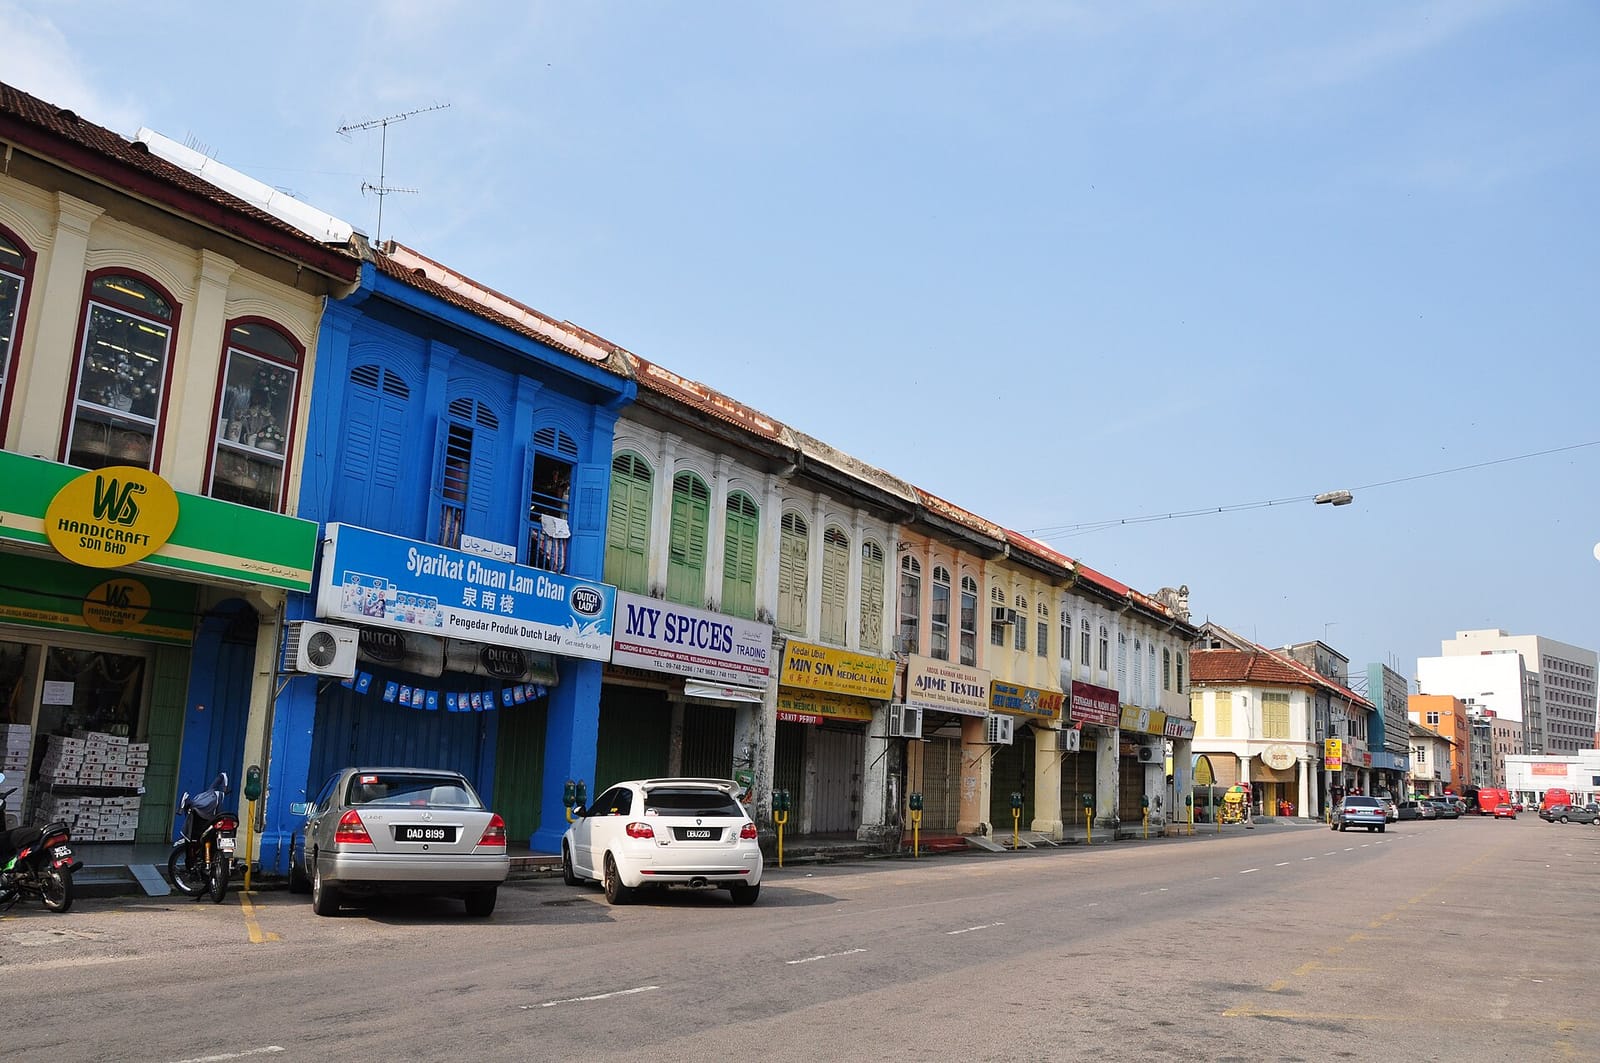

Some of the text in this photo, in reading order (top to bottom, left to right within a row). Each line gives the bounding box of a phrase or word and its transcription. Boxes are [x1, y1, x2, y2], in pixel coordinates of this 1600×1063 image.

[58, 518, 150, 546] HANDICRAFT
[79, 536, 126, 555] SDN BHD
[407, 547, 565, 601] Syarikat Chuan Lam Chan
[577, 592, 597, 605] DUTCH
[579, 601, 594, 612] LADY
[450, 614, 561, 645] Pengedar Produk Dutch Lady
[625, 604, 733, 653] MY SPICES
[361, 630, 397, 647] DUTCH
[736, 644, 766, 659] TRADING
[791, 645, 826, 659] Kedai Ubat
[654, 660, 664, 668] TEL:
[789, 657, 812, 673] MIN
[814, 662, 834, 677] SIN
[836, 670, 868, 683] MEDICAL
[870, 676, 888, 686] HALL
[914, 674, 947, 692] AJIME
[950, 680, 985, 698] TEXTILE
[407, 828, 445, 839] DAD 8199
